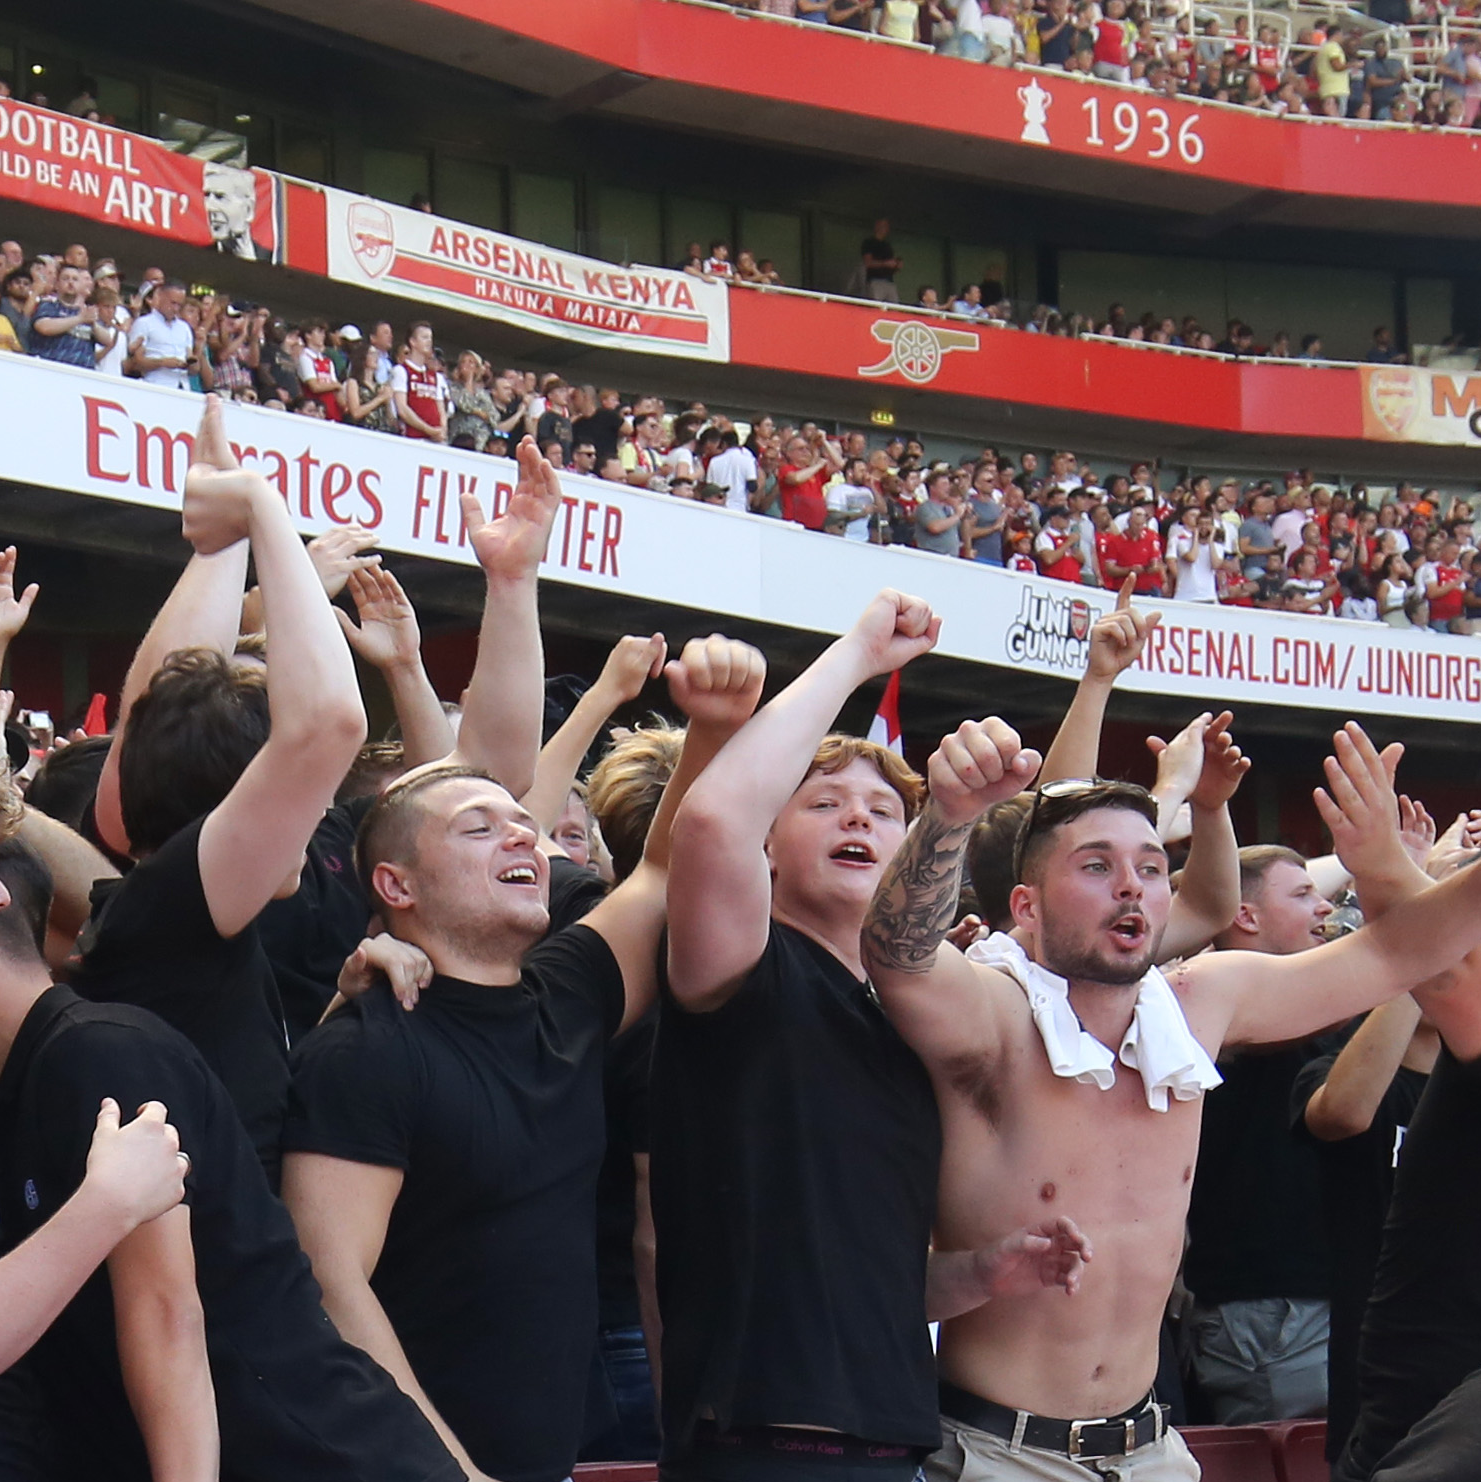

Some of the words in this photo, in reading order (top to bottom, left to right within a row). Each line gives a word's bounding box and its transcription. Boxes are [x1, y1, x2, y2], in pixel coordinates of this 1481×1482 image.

[1082, 97, 1204, 164] 1936
[36, 159, 63, 188] BE
[69, 169, 100, 198] AN
[429, 226, 574, 290] ARSENAL
[587, 271, 696, 310] KENYA
[475, 278, 554, 313] HAKUNA
[564, 301, 641, 331] MATATA
